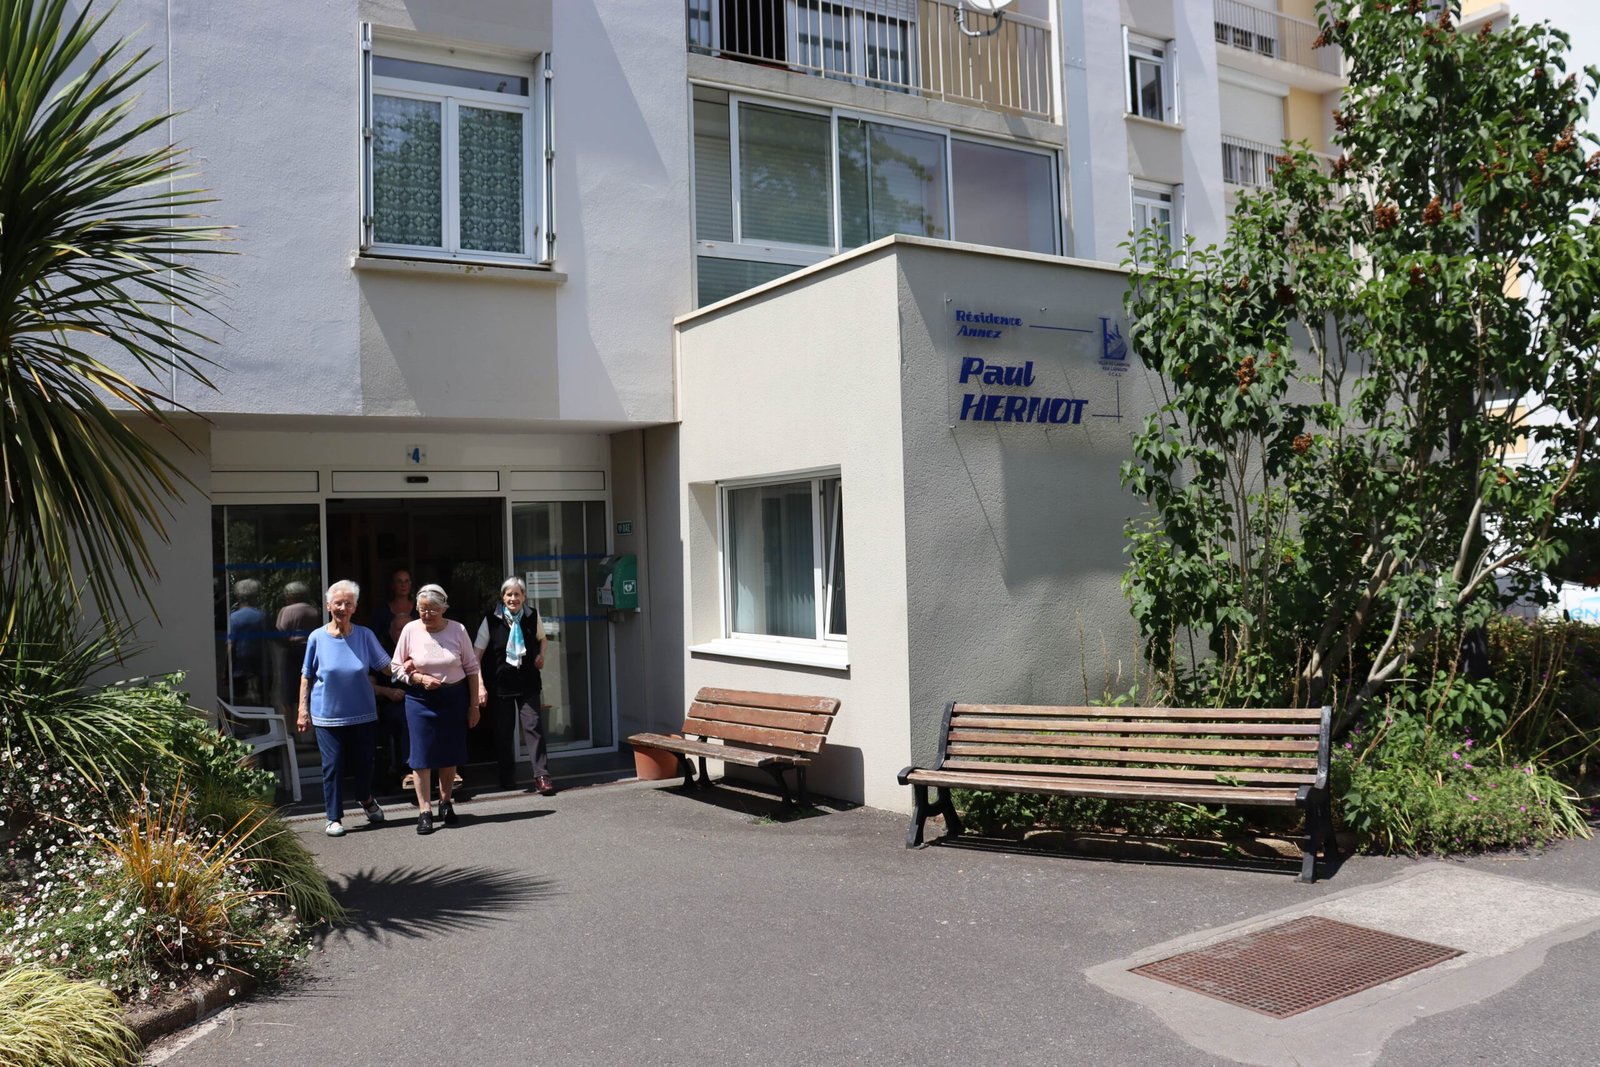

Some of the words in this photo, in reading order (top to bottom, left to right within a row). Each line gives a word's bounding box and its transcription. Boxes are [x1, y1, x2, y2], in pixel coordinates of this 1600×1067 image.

[955, 309, 1023, 327] Résidence
[958, 356, 1036, 387] Paul
[959, 393, 1089, 425] HERNOT
[412, 447, 420, 464] 4
